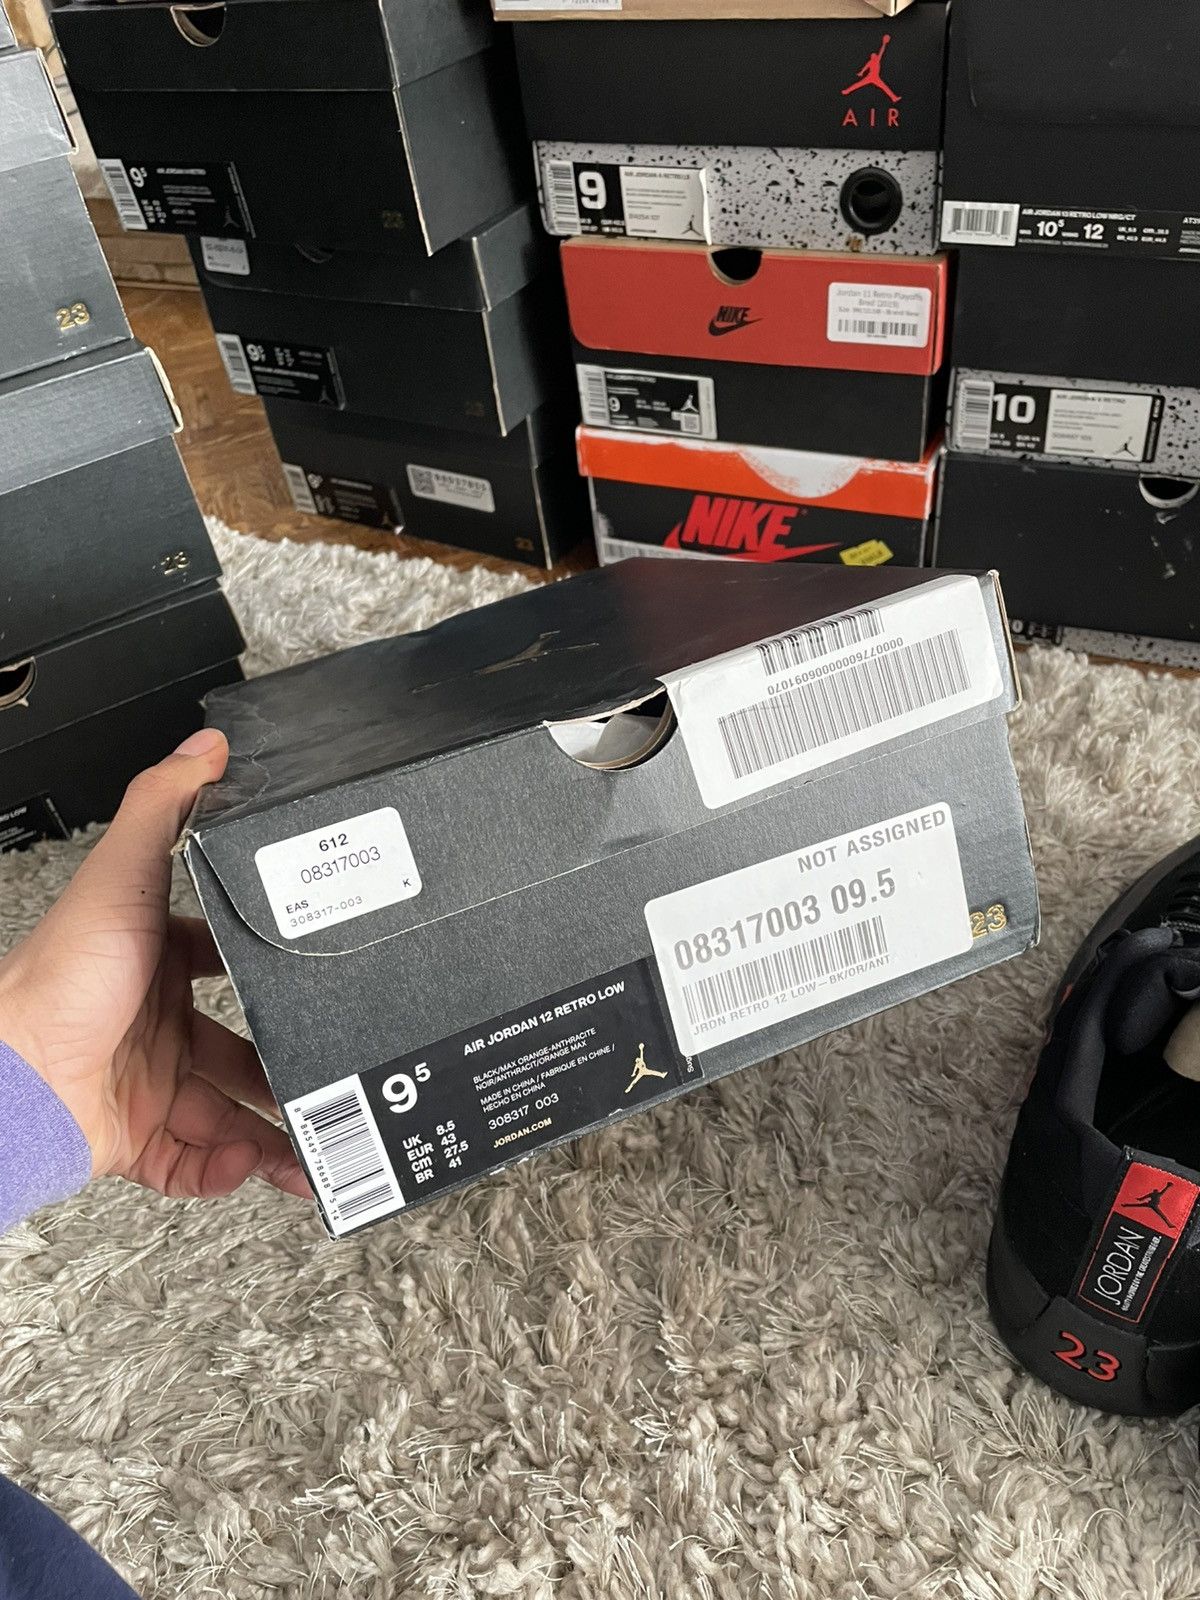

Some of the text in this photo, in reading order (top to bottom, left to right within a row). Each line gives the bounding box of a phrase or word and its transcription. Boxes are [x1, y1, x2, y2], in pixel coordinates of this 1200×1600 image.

[842, 108, 900, 126] AIR
[578, 171, 607, 210] 9
[1034, 209, 1061, 217] JORDAN
[1083, 223, 1104, 240] 12
[56, 303, 90, 331] 23
[716, 305, 751, 323] NIKE
[993, 393, 1036, 424] 10
[680, 494, 800, 551] NIKE
[160, 551, 191, 576] 23
[318, 833, 349, 852] 612
[797, 809, 947, 874] NOT ASSIGNED
[300, 846, 381, 884] 08317003
[402, 878, 413, 888] K
[285, 900, 309, 914] EAS
[290, 895, 363, 928] 308317-003
[673, 867, 896, 971] 08317003 09.5
[970, 903, 1008, 940] 23
[463, 980, 626, 1056] AIR JORDAN 12 RETRO LOW
[693, 1016, 727, 1036] JRDN
[730, 1000, 770, 1022] RETRO
[774, 992, 788, 1006] 12
[473, 1026, 597, 1084] BLACK/MAX ORANGE-ANTHRACITE
[475, 1038, 588, 1092] NOIR/ANTHRACIT/ORANGE MAX
[480, 1090, 503, 1106] MADE
[503, 1087, 512, 1097] IN
[512, 1077, 535, 1093] CHINA
[539, 1060, 577, 1081] FABRIQUE
[576, 1055, 588, 1066] EN
[588, 1045, 612, 1062] CHINE
[483, 1081, 547, 1114] HECHO EN CHINA
[488, 1092, 560, 1131] 308317 003
[403, 1119, 457, 1150] UK 8.5
[406, 1132, 457, 1162] EUR 43
[493, 1116, 553, 1149] JORDAN.COM
[411, 1140, 469, 1173] cm 27.5
[414, 1156, 463, 1184] BR 41
[1093, 1225, 1145, 1306] JORDAN
[1055, 1330, 1121, 1383] 23
